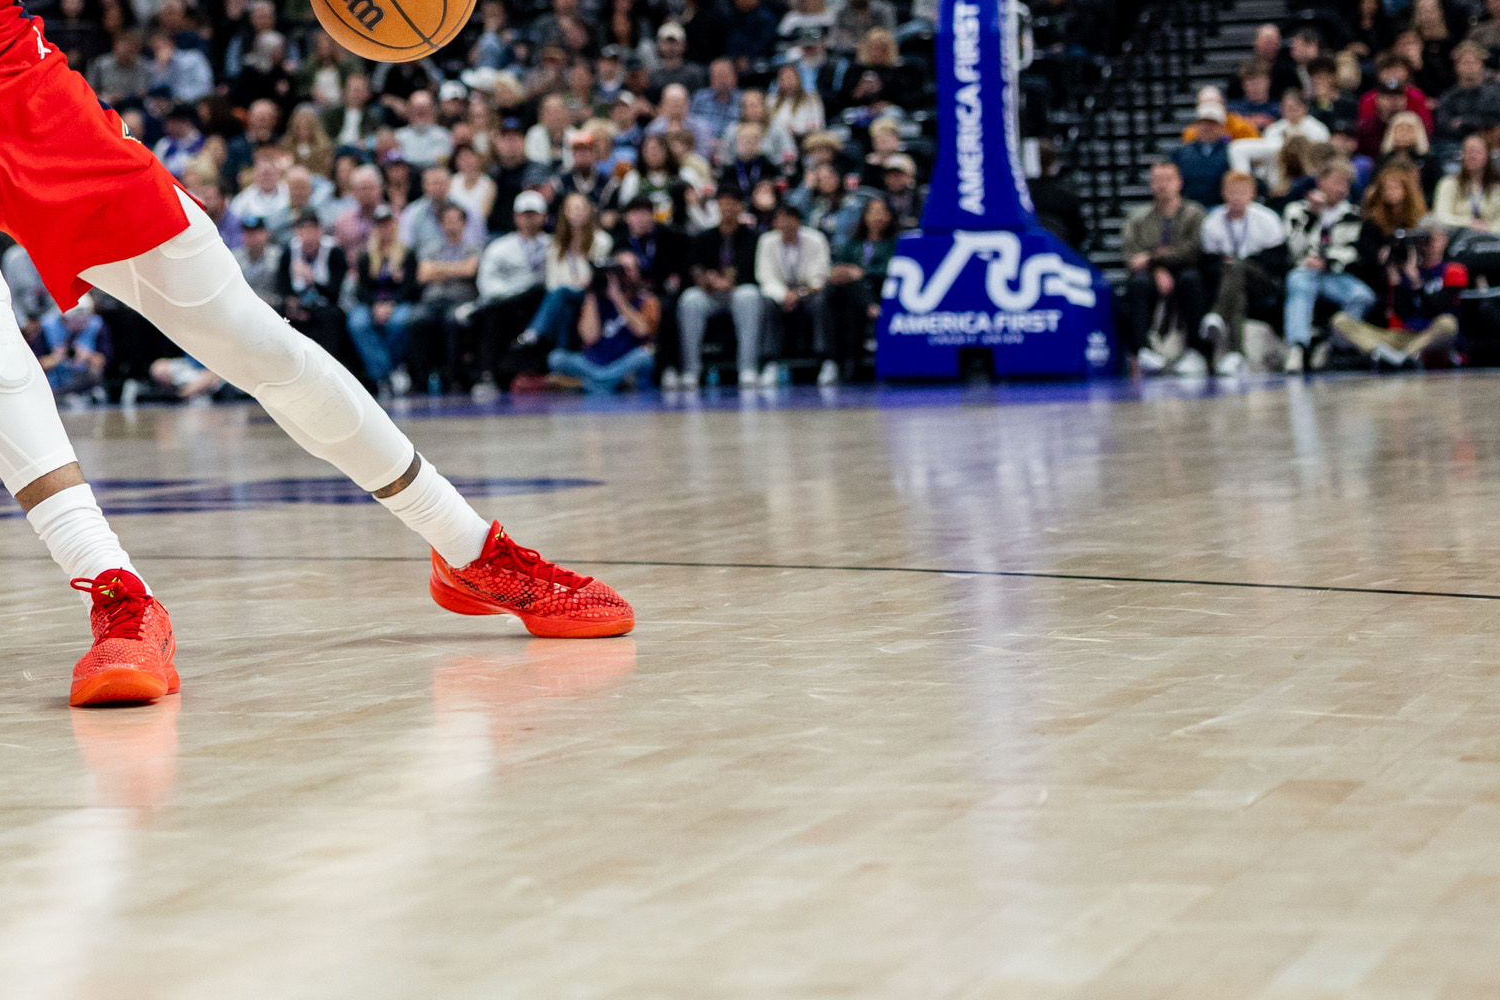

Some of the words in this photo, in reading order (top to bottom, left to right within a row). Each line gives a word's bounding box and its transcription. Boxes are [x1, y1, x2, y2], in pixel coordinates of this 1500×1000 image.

[952, 0, 982, 83] FIRST
[954, 83, 986, 216] AMERICA
[888, 311, 990, 336] AMERICA
[992, 309, 1063, 333] FIRST
